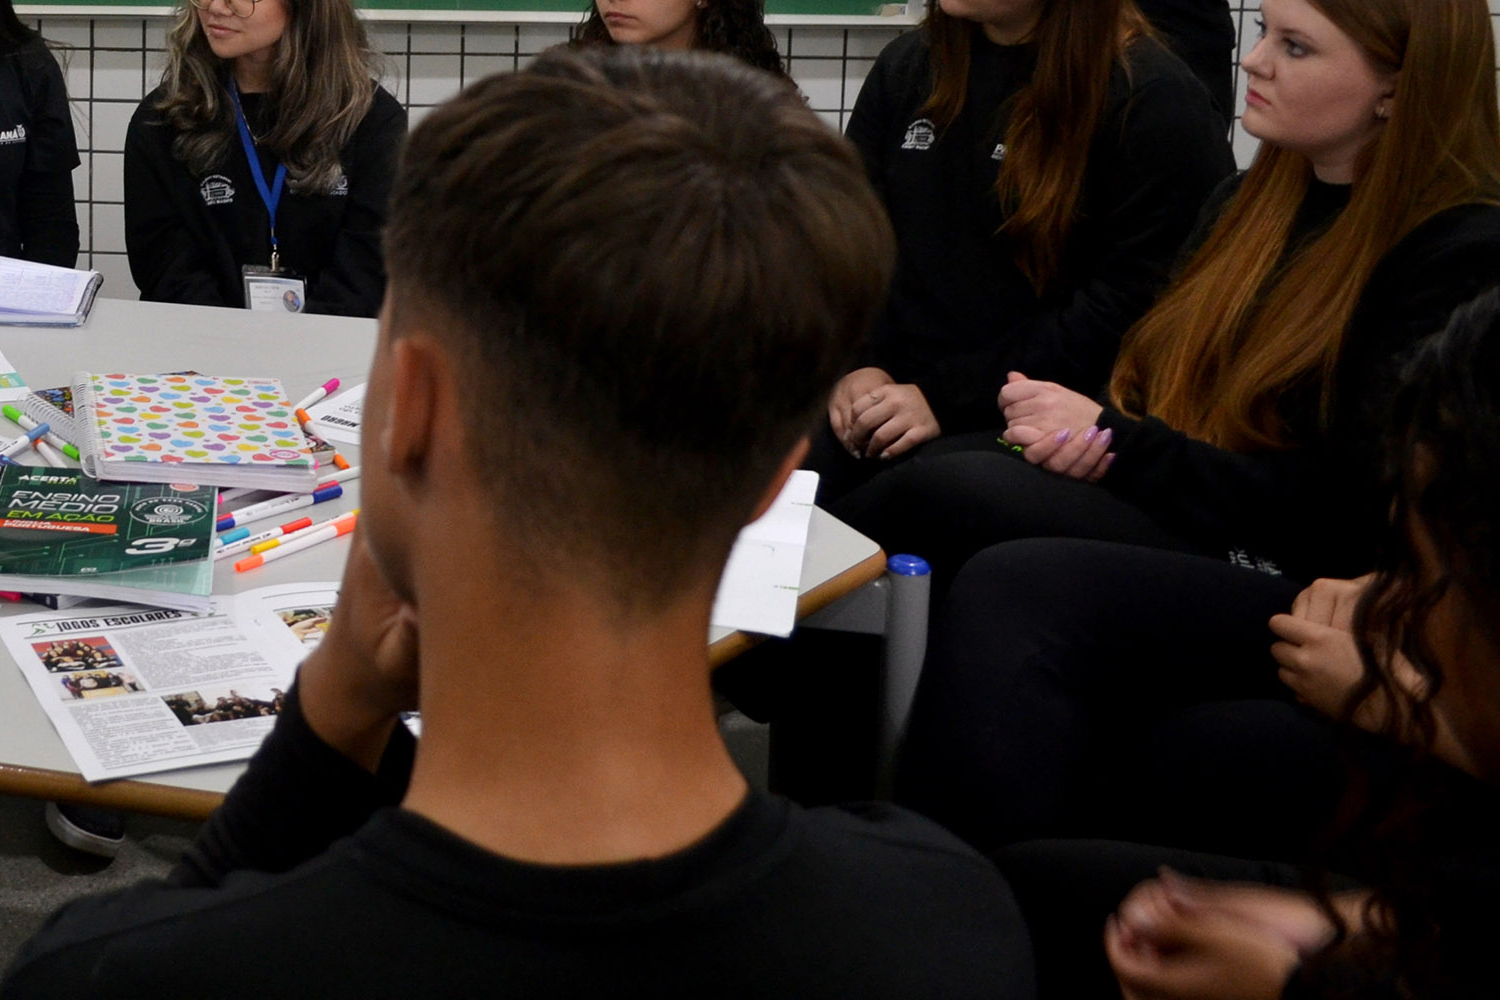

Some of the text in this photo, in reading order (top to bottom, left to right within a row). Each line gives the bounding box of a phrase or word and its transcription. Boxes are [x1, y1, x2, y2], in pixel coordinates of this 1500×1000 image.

[18, 474, 78, 483] ACERTA
[12, 489, 121, 503] ENSINO
[8, 498, 120, 514] MÉDIO
[7, 509, 115, 523] EM AÇÃO
[3, 522, 90, 533] PORTUGUESA
[56, 609, 183, 633] JOGOS ESCOLARES
